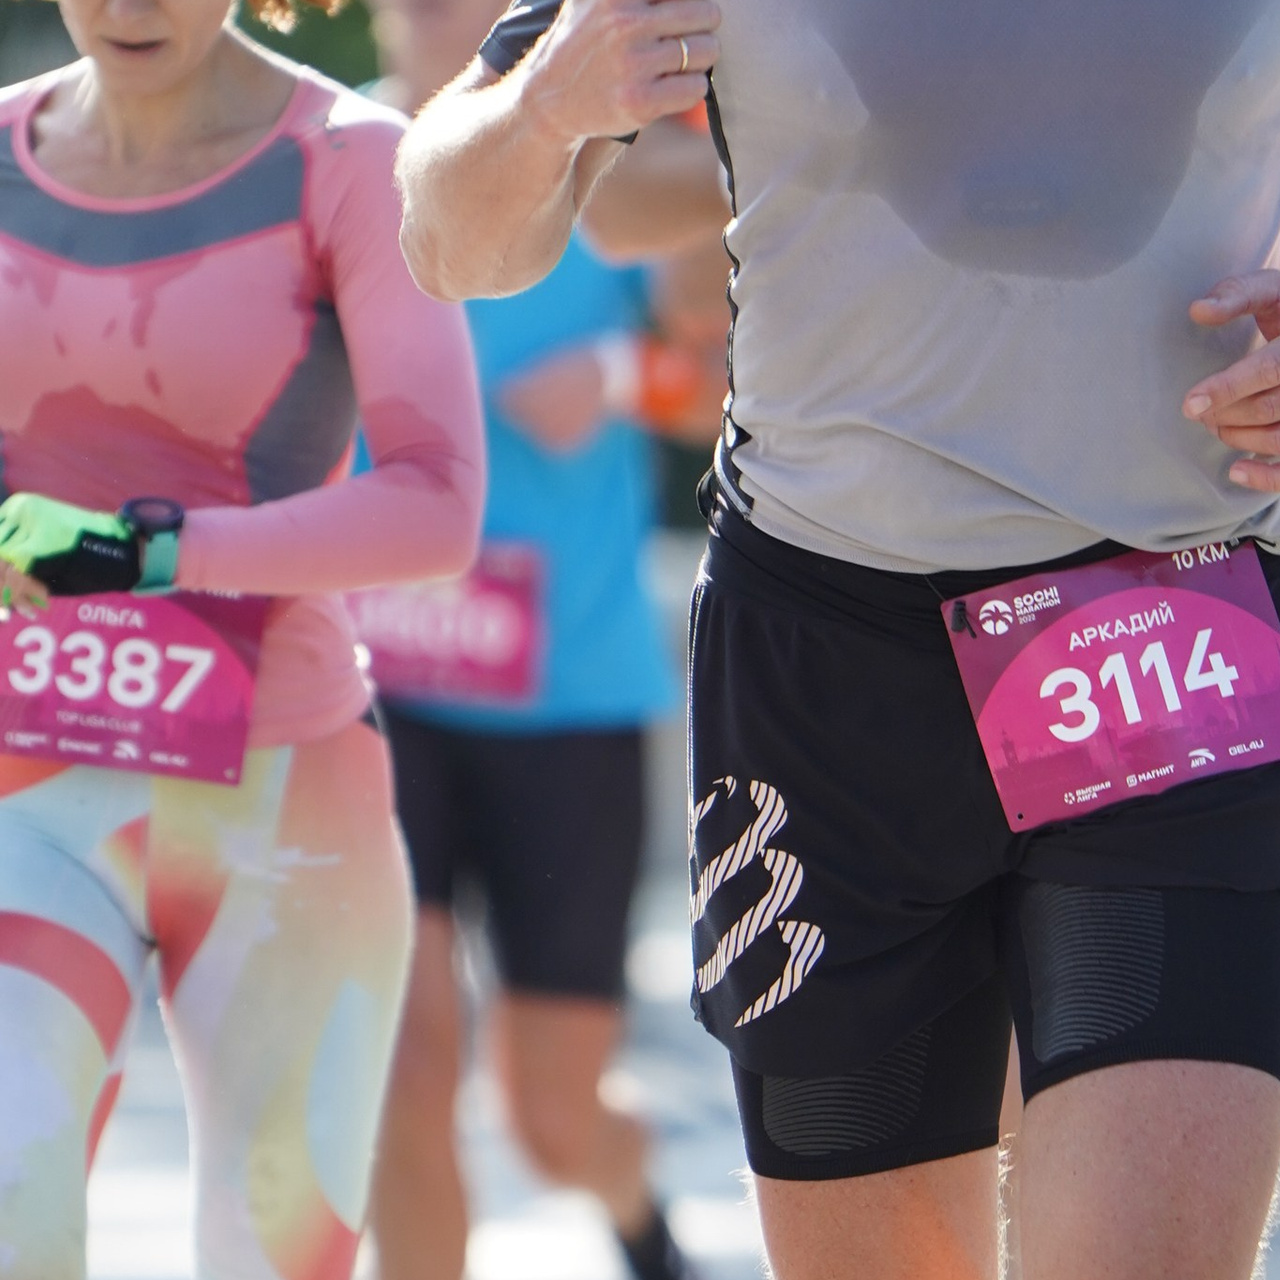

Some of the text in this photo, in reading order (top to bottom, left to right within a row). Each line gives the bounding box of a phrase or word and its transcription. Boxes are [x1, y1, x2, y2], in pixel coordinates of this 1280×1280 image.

[1172, 542, 1231, 571] 10 KM
[1013, 586, 1060, 609] SOCHI
[1015, 598, 1061, 617] MARATHON
[77, 603, 146, 629] ОЛЬГА
[1068, 601, 1175, 651] АРКАДИЙ
[7, 625, 215, 713] 3387
[1039, 628, 1240, 743] 3114
[1138, 763, 1175, 783] МАГНИТ
[1075, 780, 1112, 797] ВЫСШАЯ
